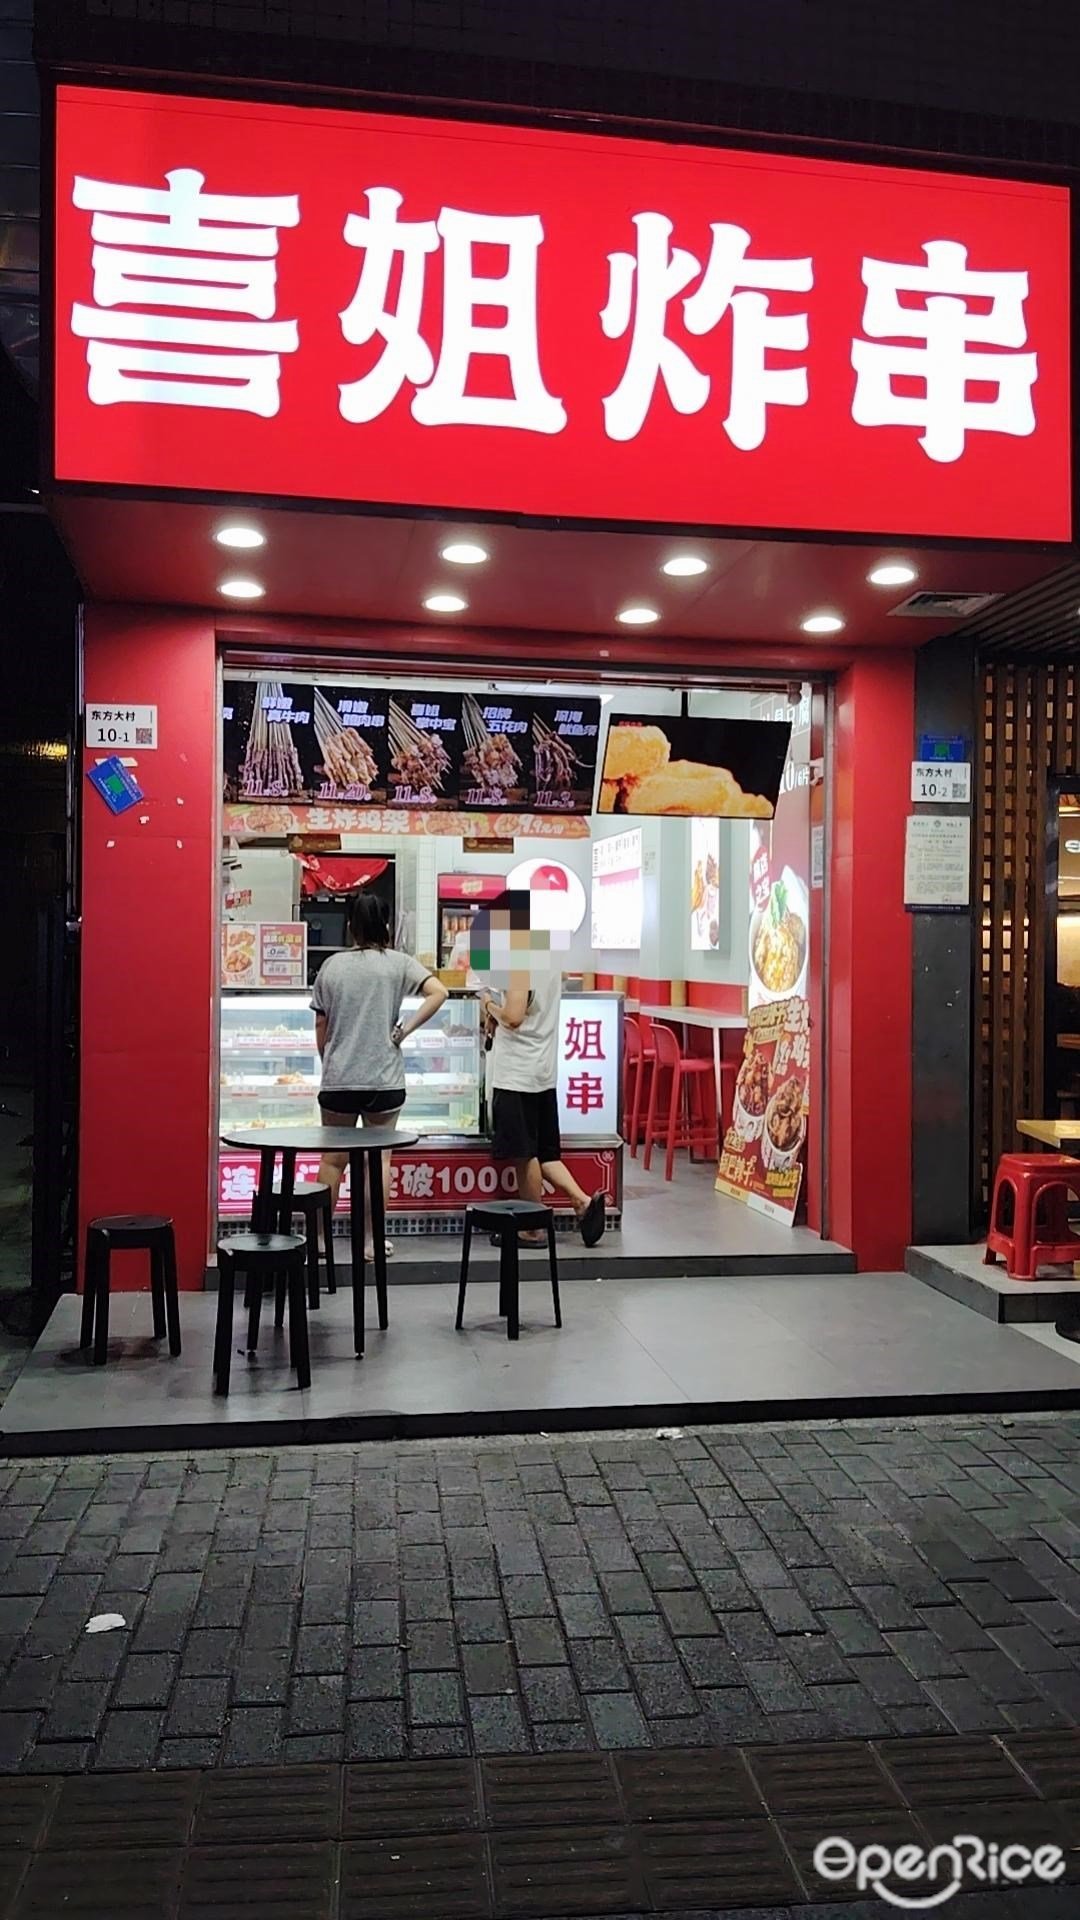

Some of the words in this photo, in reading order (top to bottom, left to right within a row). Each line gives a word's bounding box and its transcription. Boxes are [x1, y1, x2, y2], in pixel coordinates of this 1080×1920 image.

[72, 168, 1038, 463] 喜姐炸串
[91, 710, 136, 722] 东方大村
[486, 720, 528, 733] 五花肉
[97, 727, 130, 743] 10-1
[916, 767, 953, 778] 东方大村
[921, 783, 948, 797] 10-2
[306, 807, 410, 834] 生炸鸡架
[564, 1017, 607, 1061] 姐
[566, 1071, 604, 1115] 串
